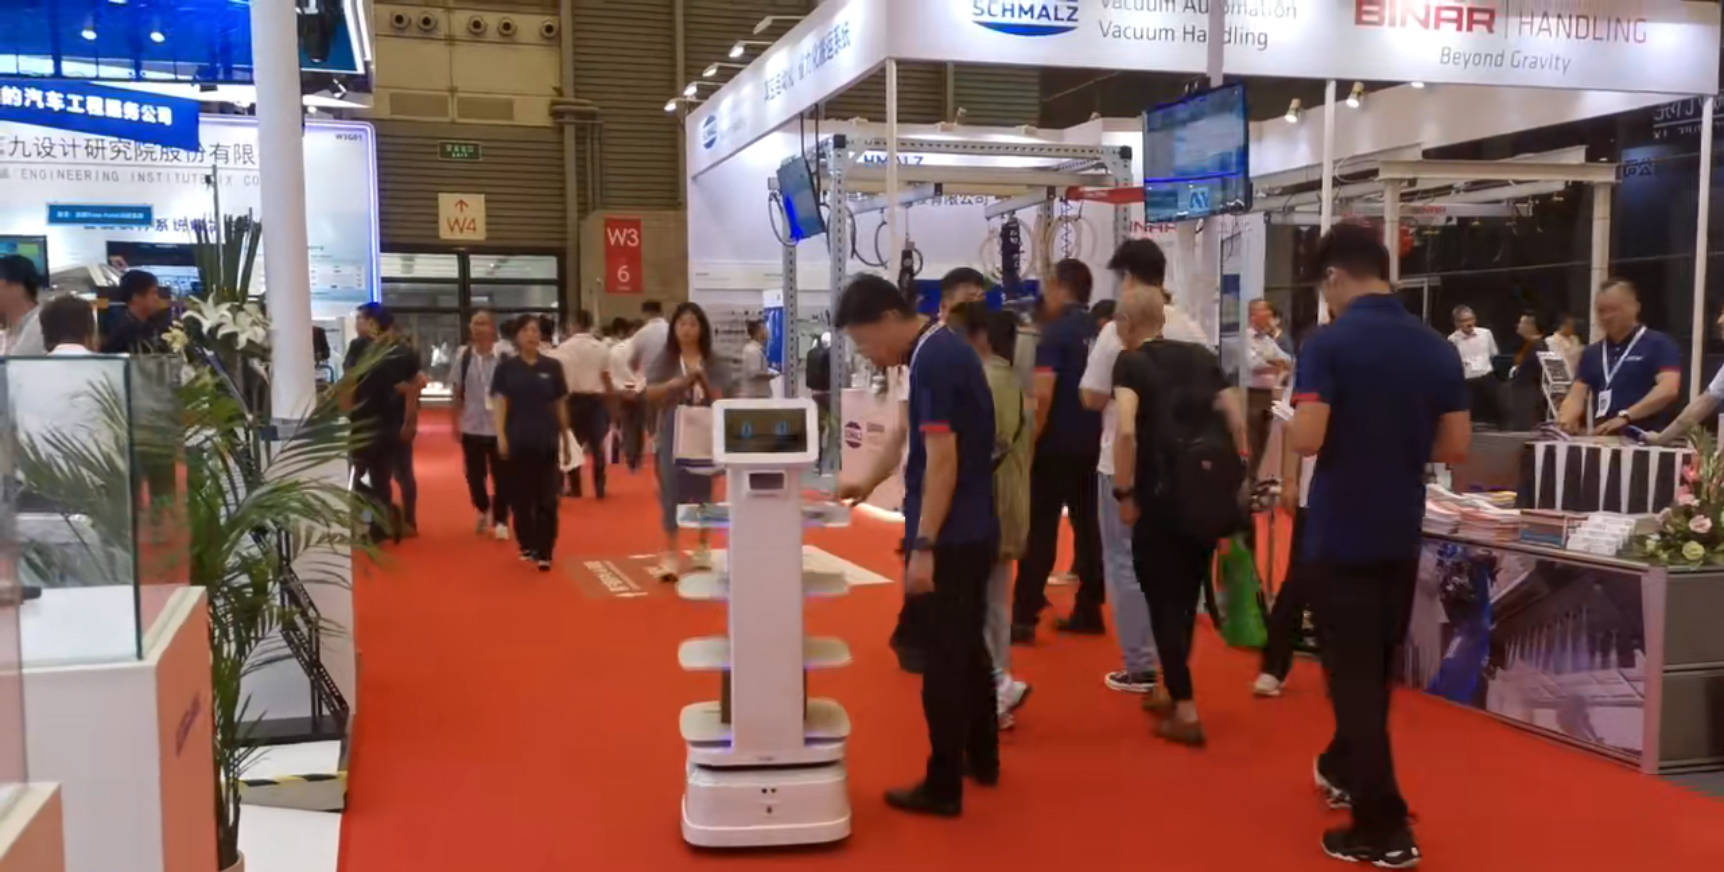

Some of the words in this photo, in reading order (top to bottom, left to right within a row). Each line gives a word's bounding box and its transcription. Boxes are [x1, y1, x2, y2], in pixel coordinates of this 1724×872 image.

[973, 2, 1079, 22] SCHMALZ
[1182, 0, 1297, 18] Aumation
[1100, 20, 1175, 42] Vacuum
[1182, 25, 1268, 50] Hadling
[1518, 13, 1647, 43] HANDLING
[1440, 46, 1504, 68] Beyond
[1511, 50, 1571, 75] Gravity
[447, 217, 477, 233] W4
[607, 227, 640, 246] W3
[617, 264, 630, 283] 6
